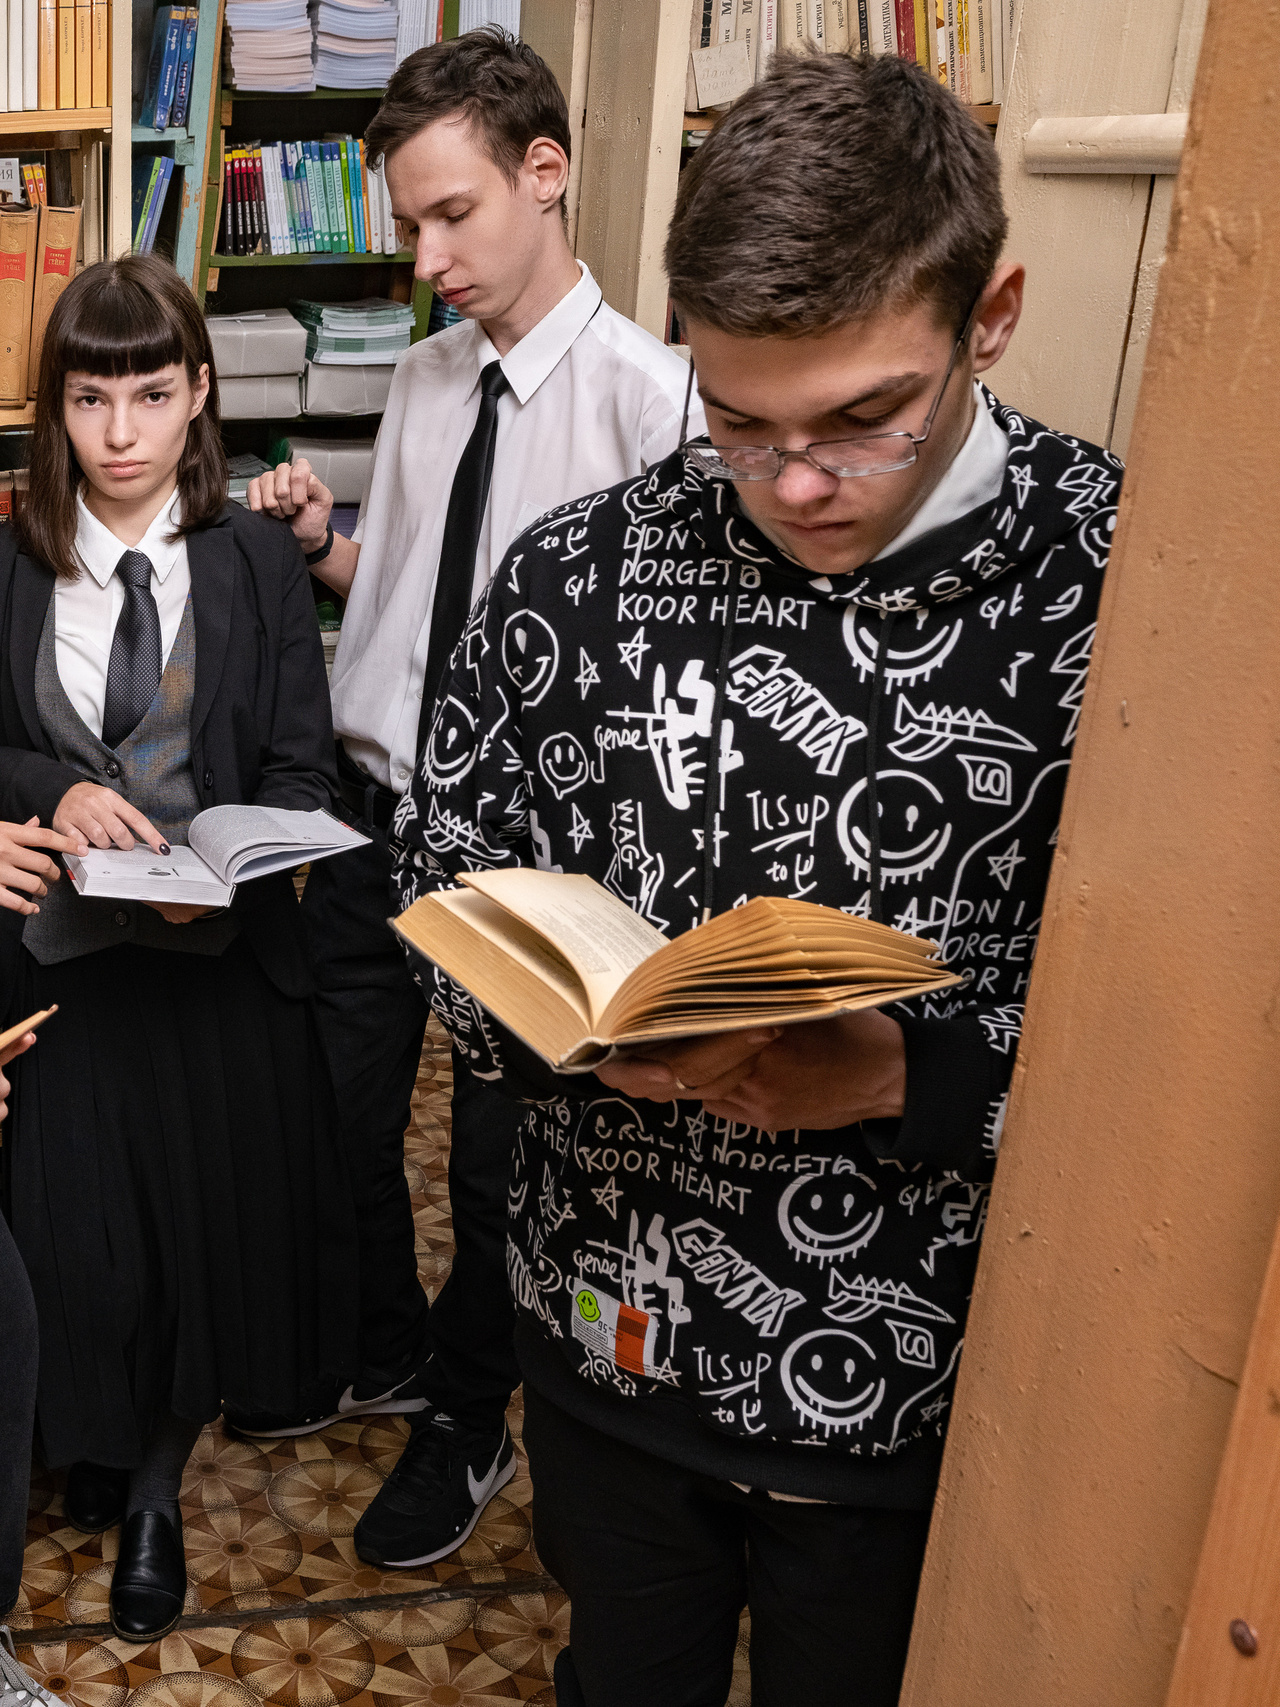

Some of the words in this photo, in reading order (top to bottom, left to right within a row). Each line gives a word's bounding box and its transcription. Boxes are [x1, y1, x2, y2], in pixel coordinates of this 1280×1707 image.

[766, 5, 774, 40] ИСТОРИЯ
[795, 2, 803, 38] ИСТОРИЯ
[814, 3, 823, 39] ИСТОРИЯ
[881, 2, 892, 50] МАТЕМАТИКА
[977, 5, 986, 74] экзаменационные
[235, 160, 239, 168] 6
[28, 184, 34, 192] 7
[38, 183, 44, 192] 7
[48, 258, 65, 266] ГЕЙНЕ
[619, 592, 696, 625] KOOR
[710, 595, 816, 630] HEART
[767, 863, 787, 882] to
[584, 1148, 660, 1181] KOOR
[671, 1161, 752, 1215] HEART
[575, 1317, 607, 1343] COLLECTION
[598, 1321, 608, 1334] 95
[713, 1407, 734, 1424] to
